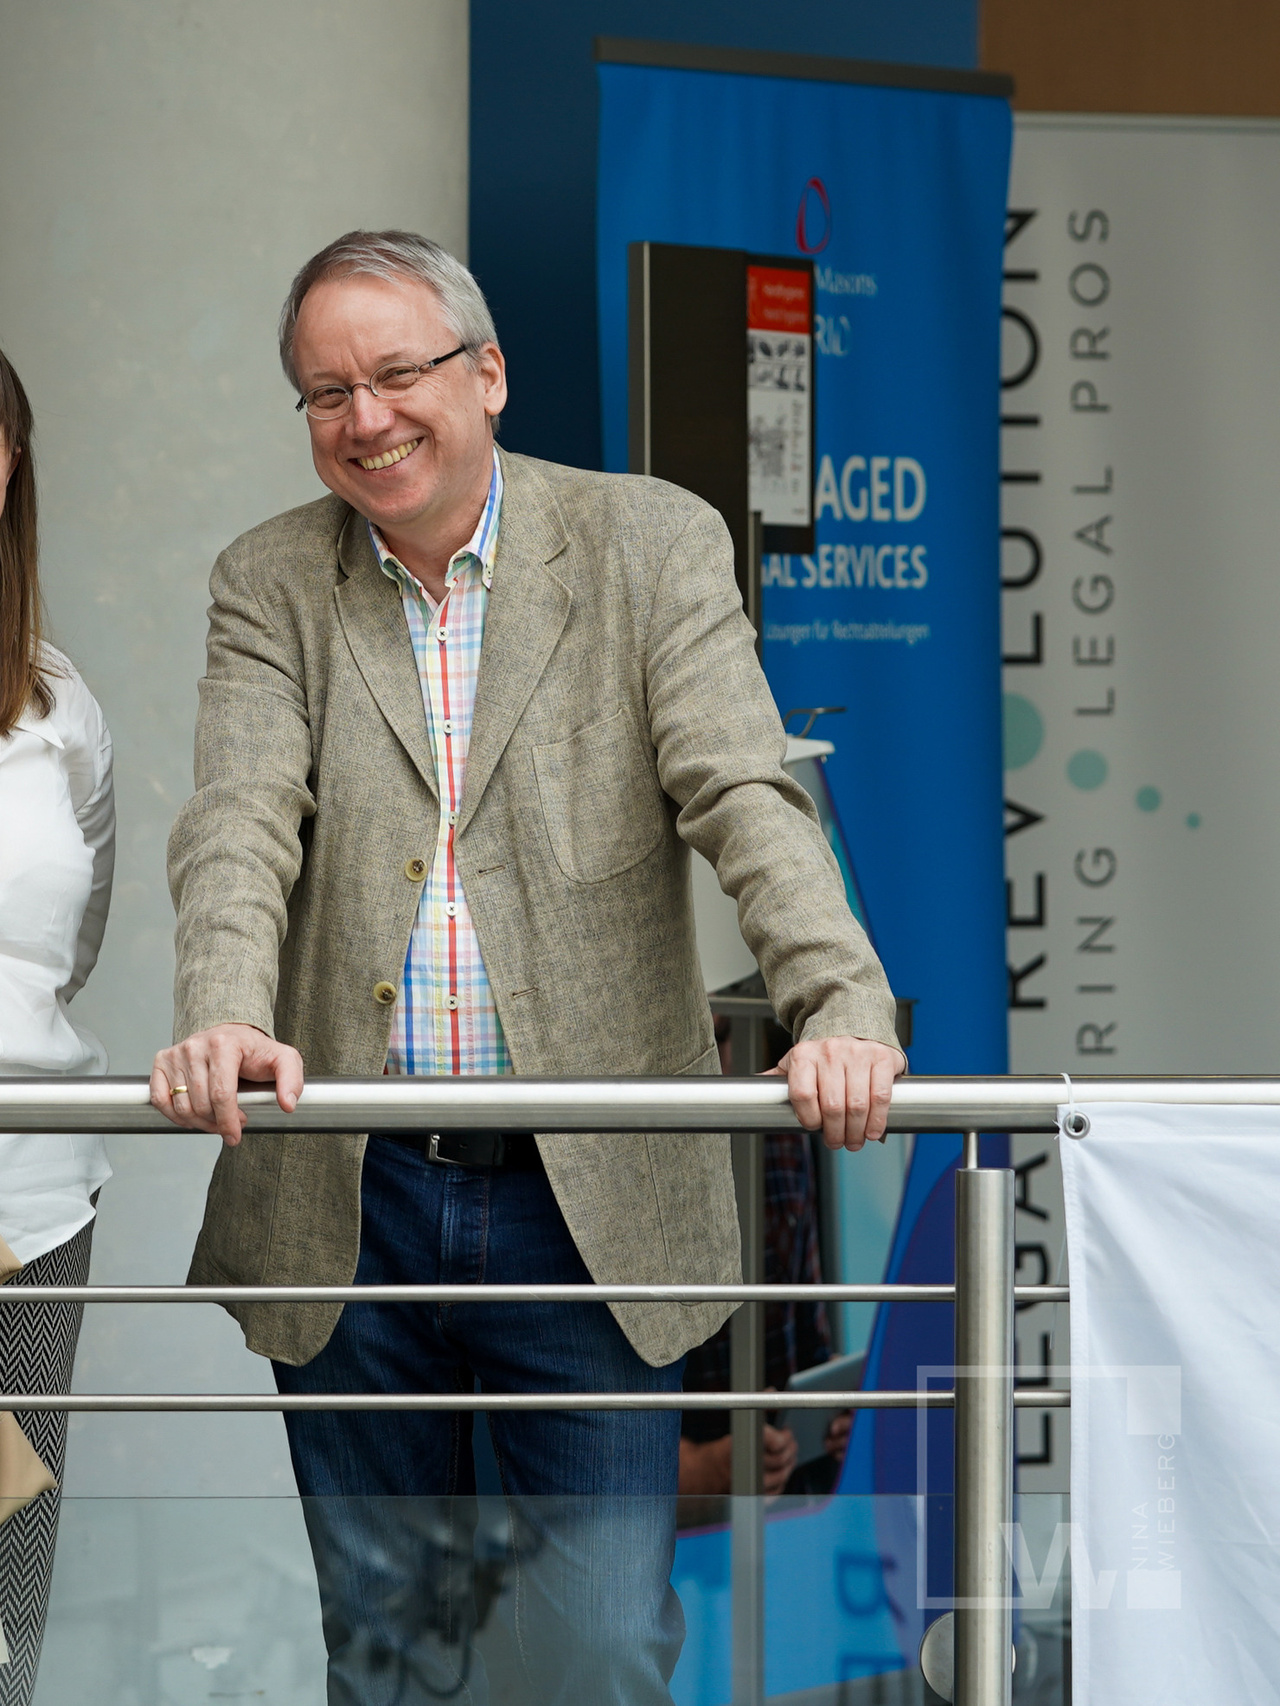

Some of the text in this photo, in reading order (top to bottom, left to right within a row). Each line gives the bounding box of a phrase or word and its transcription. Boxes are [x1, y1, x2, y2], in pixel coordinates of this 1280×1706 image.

[1067, 208, 1112, 414] PROS
[814, 453, 928, 523] AGED
[800, 543, 929, 590] SERVICES
[1071, 464, 1116, 718] LEGAL
